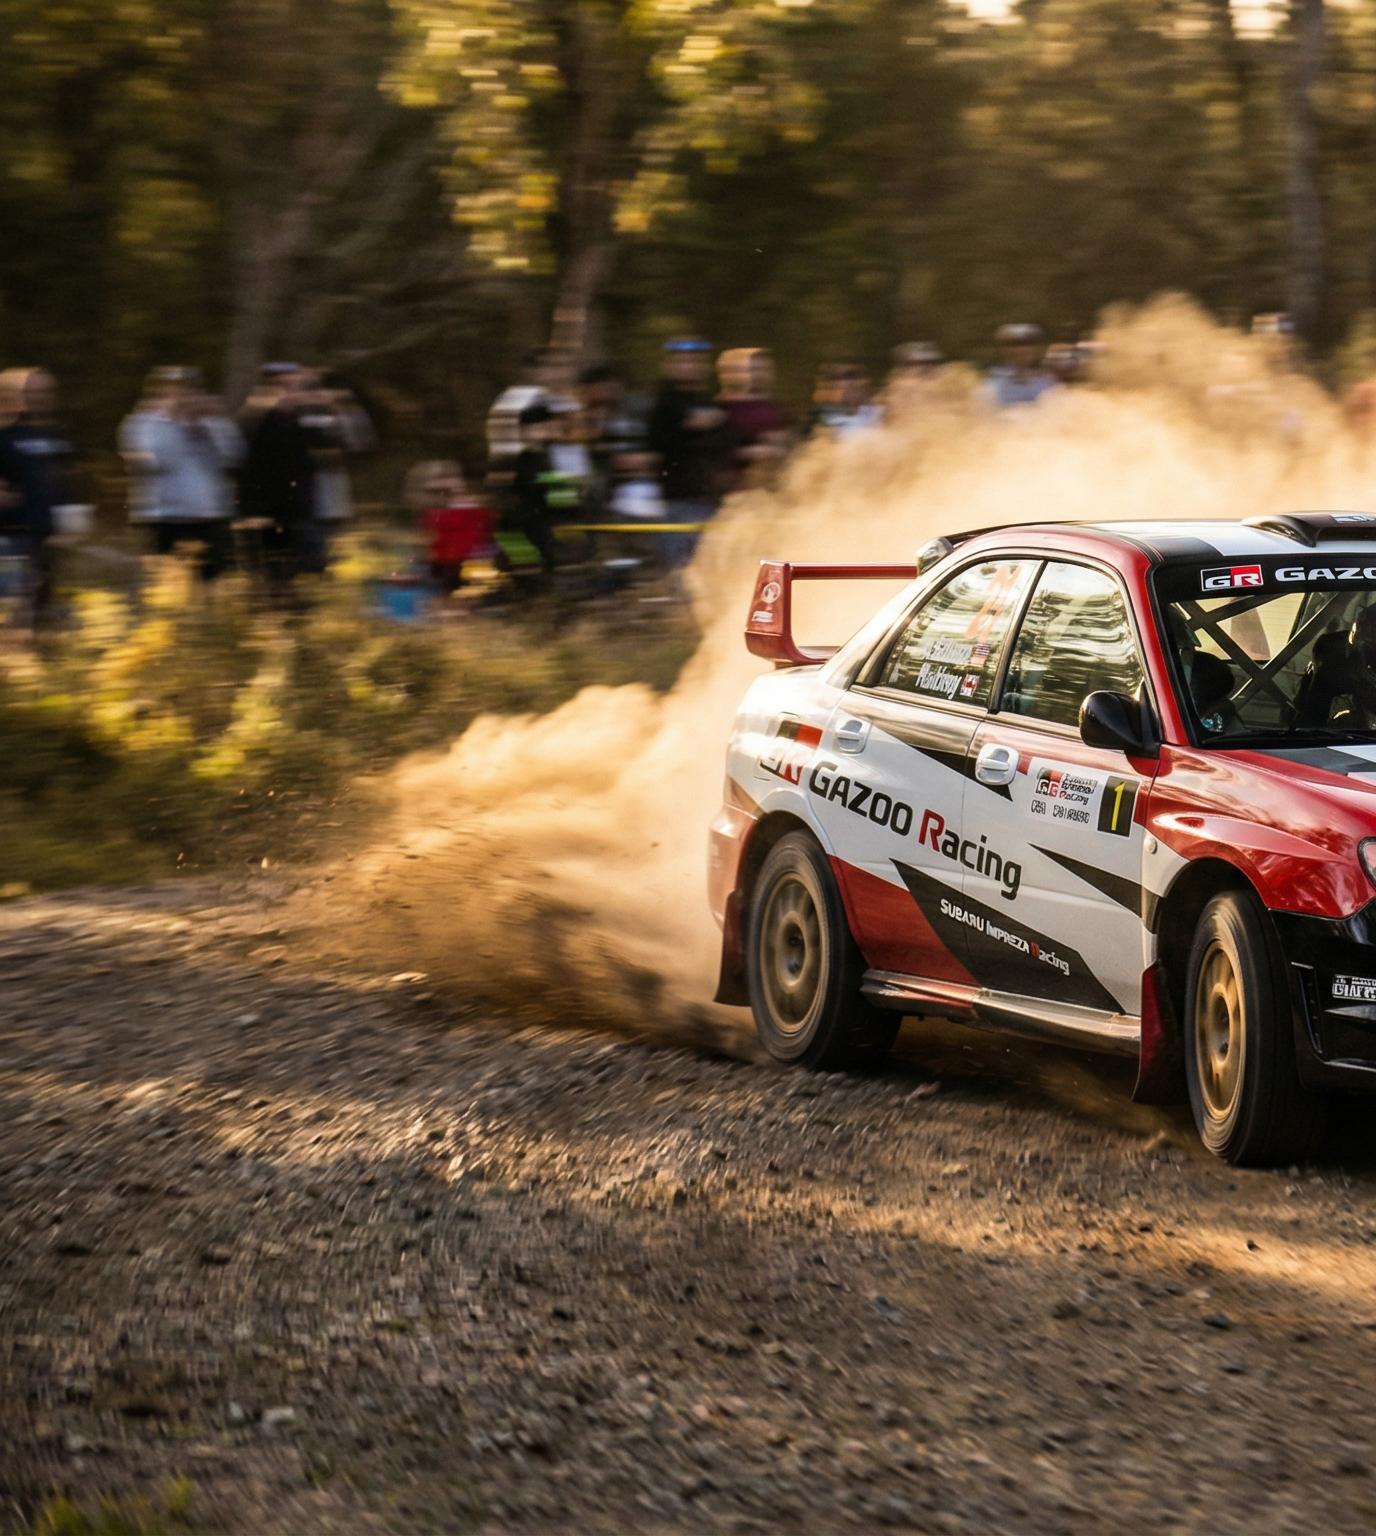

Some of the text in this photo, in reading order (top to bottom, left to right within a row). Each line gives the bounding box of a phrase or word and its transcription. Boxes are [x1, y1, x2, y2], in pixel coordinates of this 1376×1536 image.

[1203, 571, 1262, 589] GR
[1112, 781, 1126, 831] 1
[809, 761, 913, 836] GAZOO
[918, 809, 1021, 900] Racing
[940, 898, 985, 931] SUBARU
